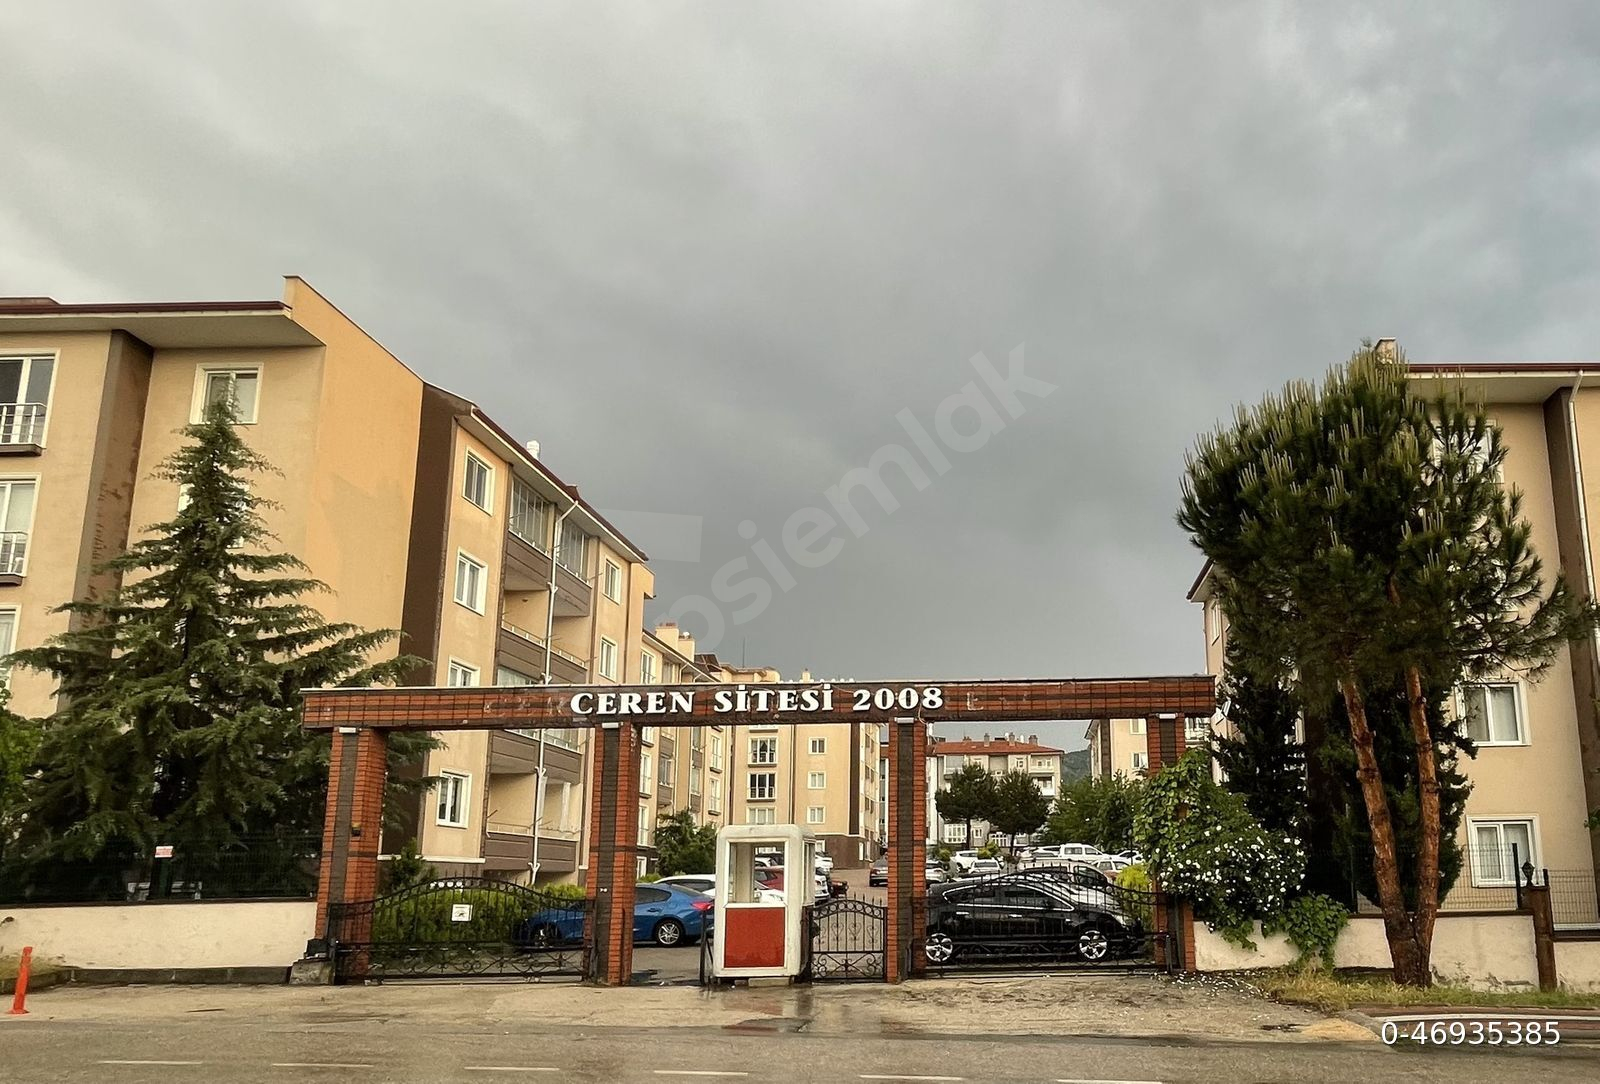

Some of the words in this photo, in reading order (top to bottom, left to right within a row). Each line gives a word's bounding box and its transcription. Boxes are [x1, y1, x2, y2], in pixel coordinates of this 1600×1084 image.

[570, 691, 695, 715] CEREN
[713, 683, 834, 713] SİTESİ
[852, 687, 943, 711] 2008
